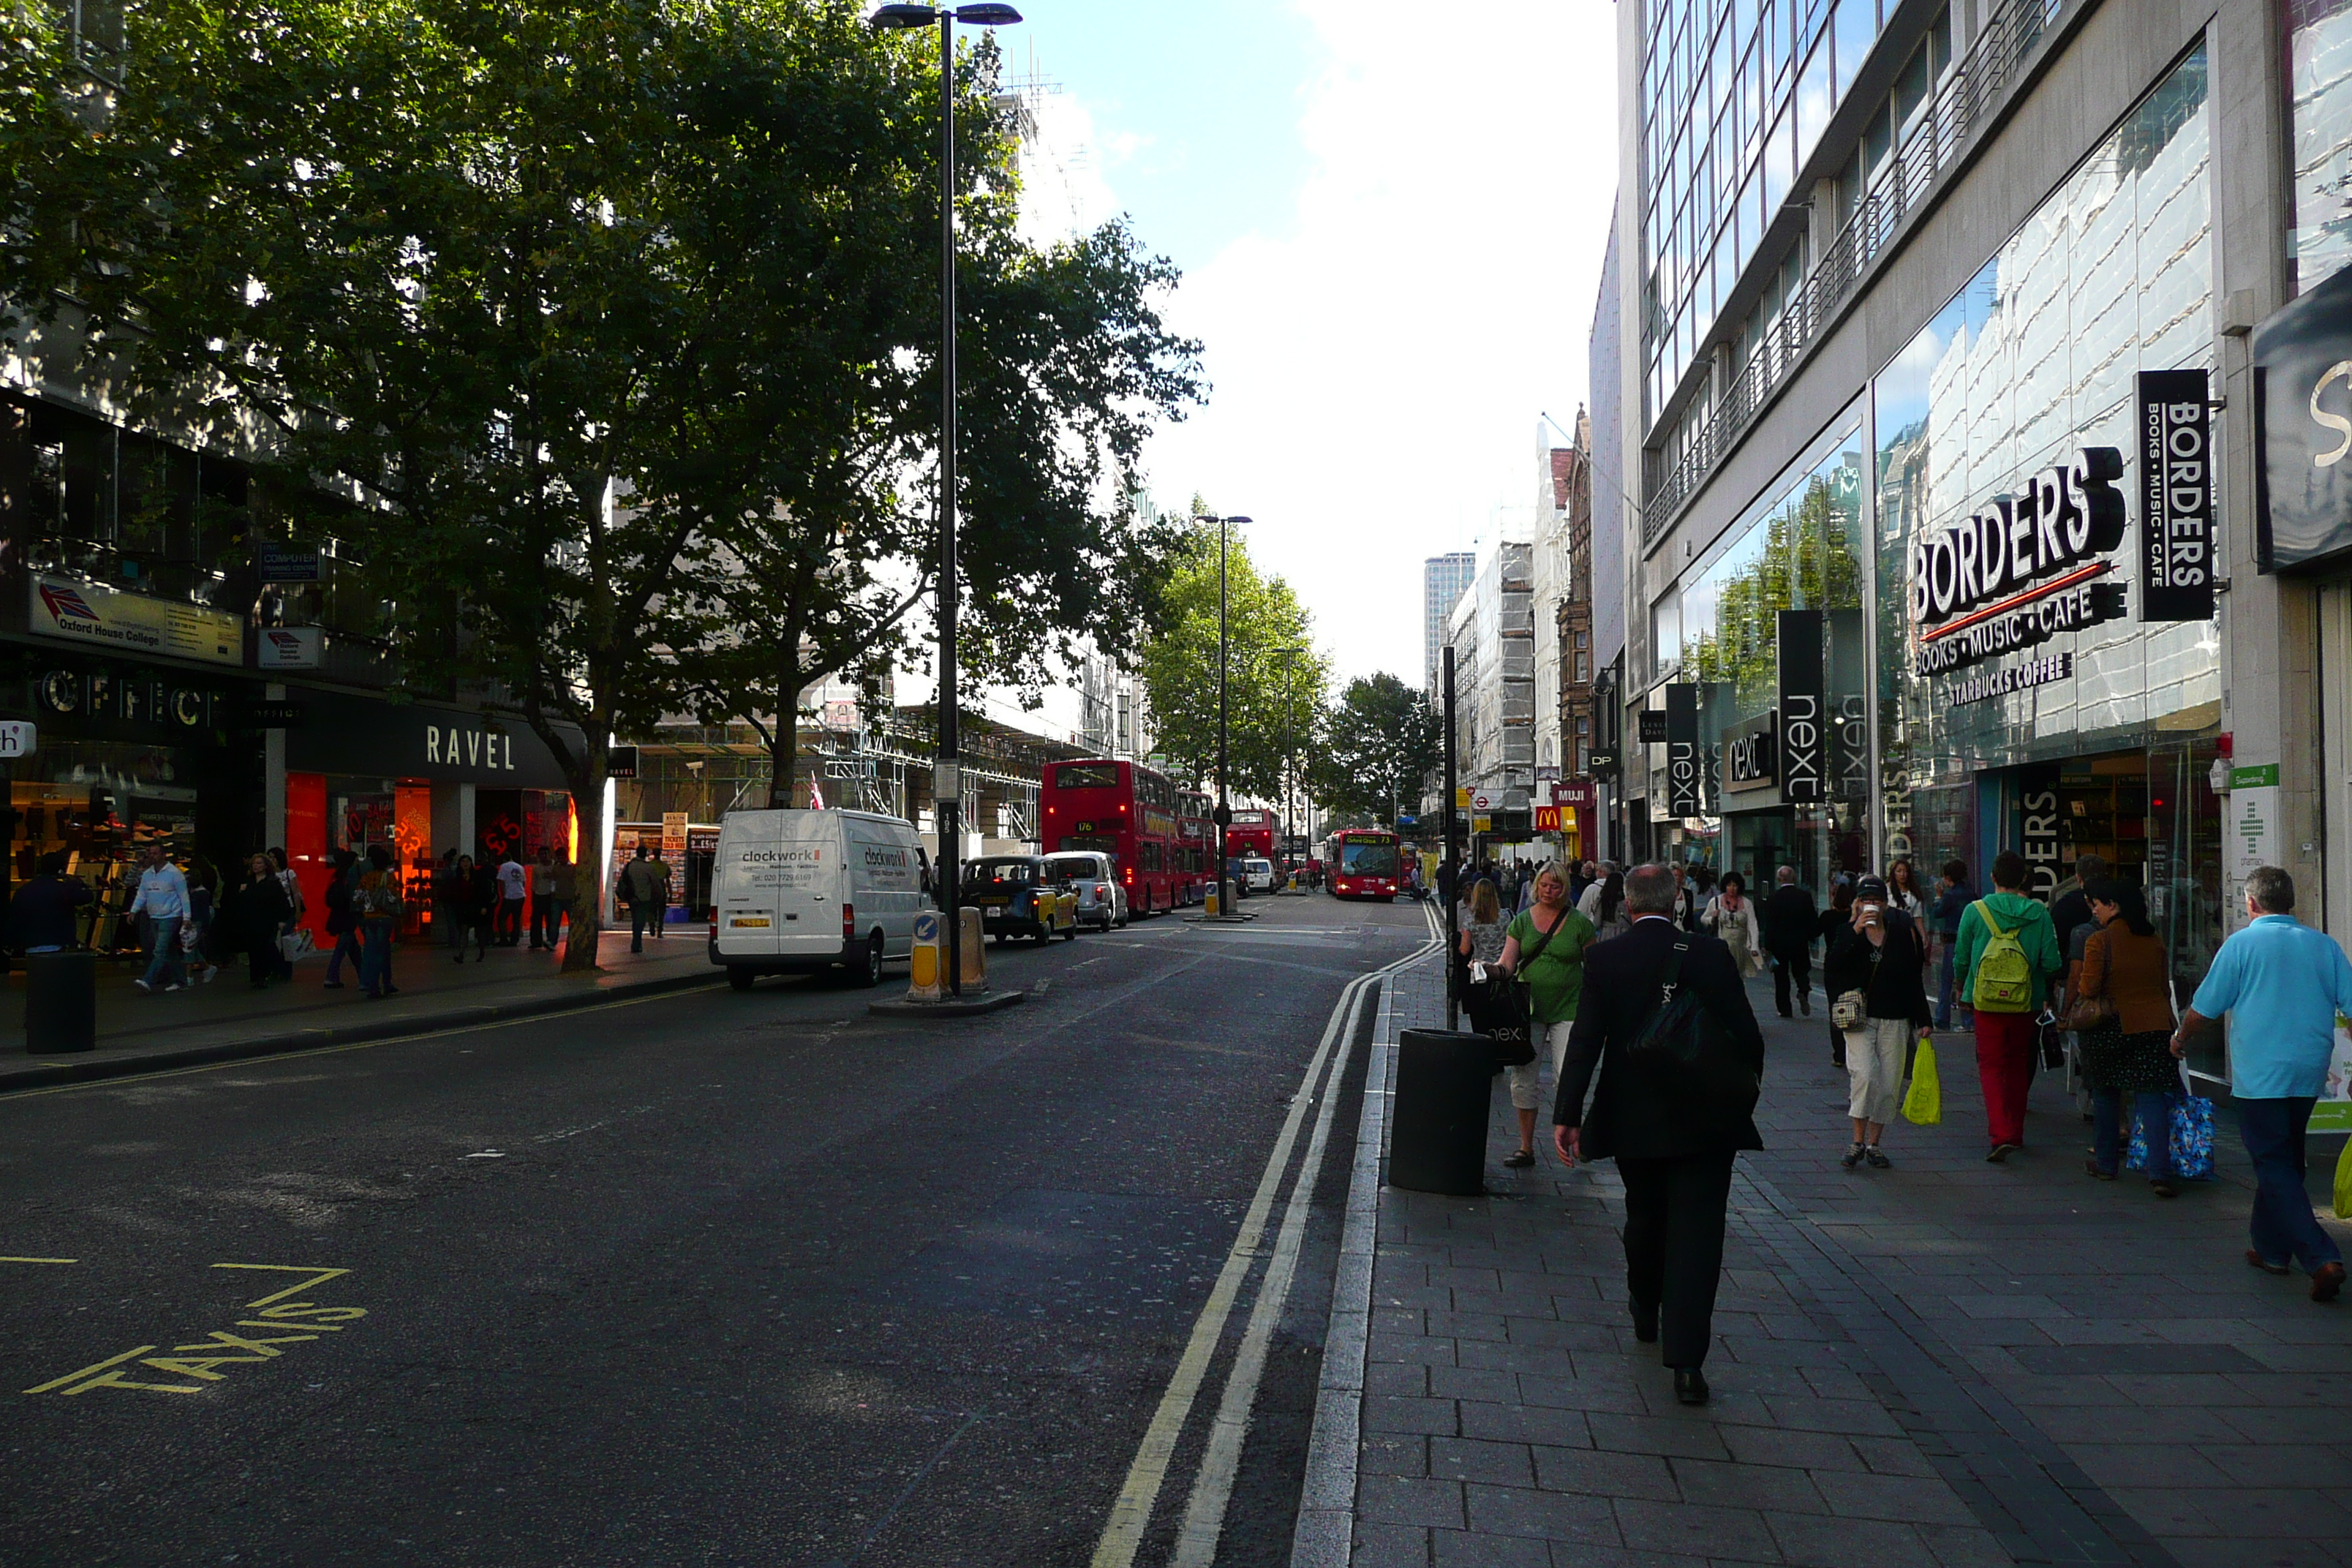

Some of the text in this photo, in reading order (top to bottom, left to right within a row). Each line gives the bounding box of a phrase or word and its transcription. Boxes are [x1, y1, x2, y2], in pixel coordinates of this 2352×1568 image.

[2148, 402, 2163, 588] BOOKS MUSIC CAFE
[2168, 401, 2204, 588] BORDERS
[1915, 447, 2093, 624] BORDERS
[263, 553, 317, 563] COMPUTER
[60, 618, 92, 635] Oxford
[94, 624, 124, 639] House
[126, 630, 159, 647] College
[1914, 586, 2094, 677] BOOKS MUSIC CAFE
[1948, 652, 2065, 706] STARBUCKS COFFEE
[0, 729, 17, 752] h
[426, 725, 516, 770] RAVEL
[1729, 731, 1760, 783] next
[1787, 694, 1819, 797] next
[609, 768, 634, 776] RAVEL
[1591, 755, 1612, 766] DP
[1672, 742, 1695, 814] next
[1558, 789, 1585, 802] MUJI
[1078, 821, 1093, 832] 176
[1381, 836, 1390, 844] 73
[742, 849, 813, 862] clockwork
[864, 846, 902, 867] clockwork
[61, 1301, 369, 1396] TAXIS
